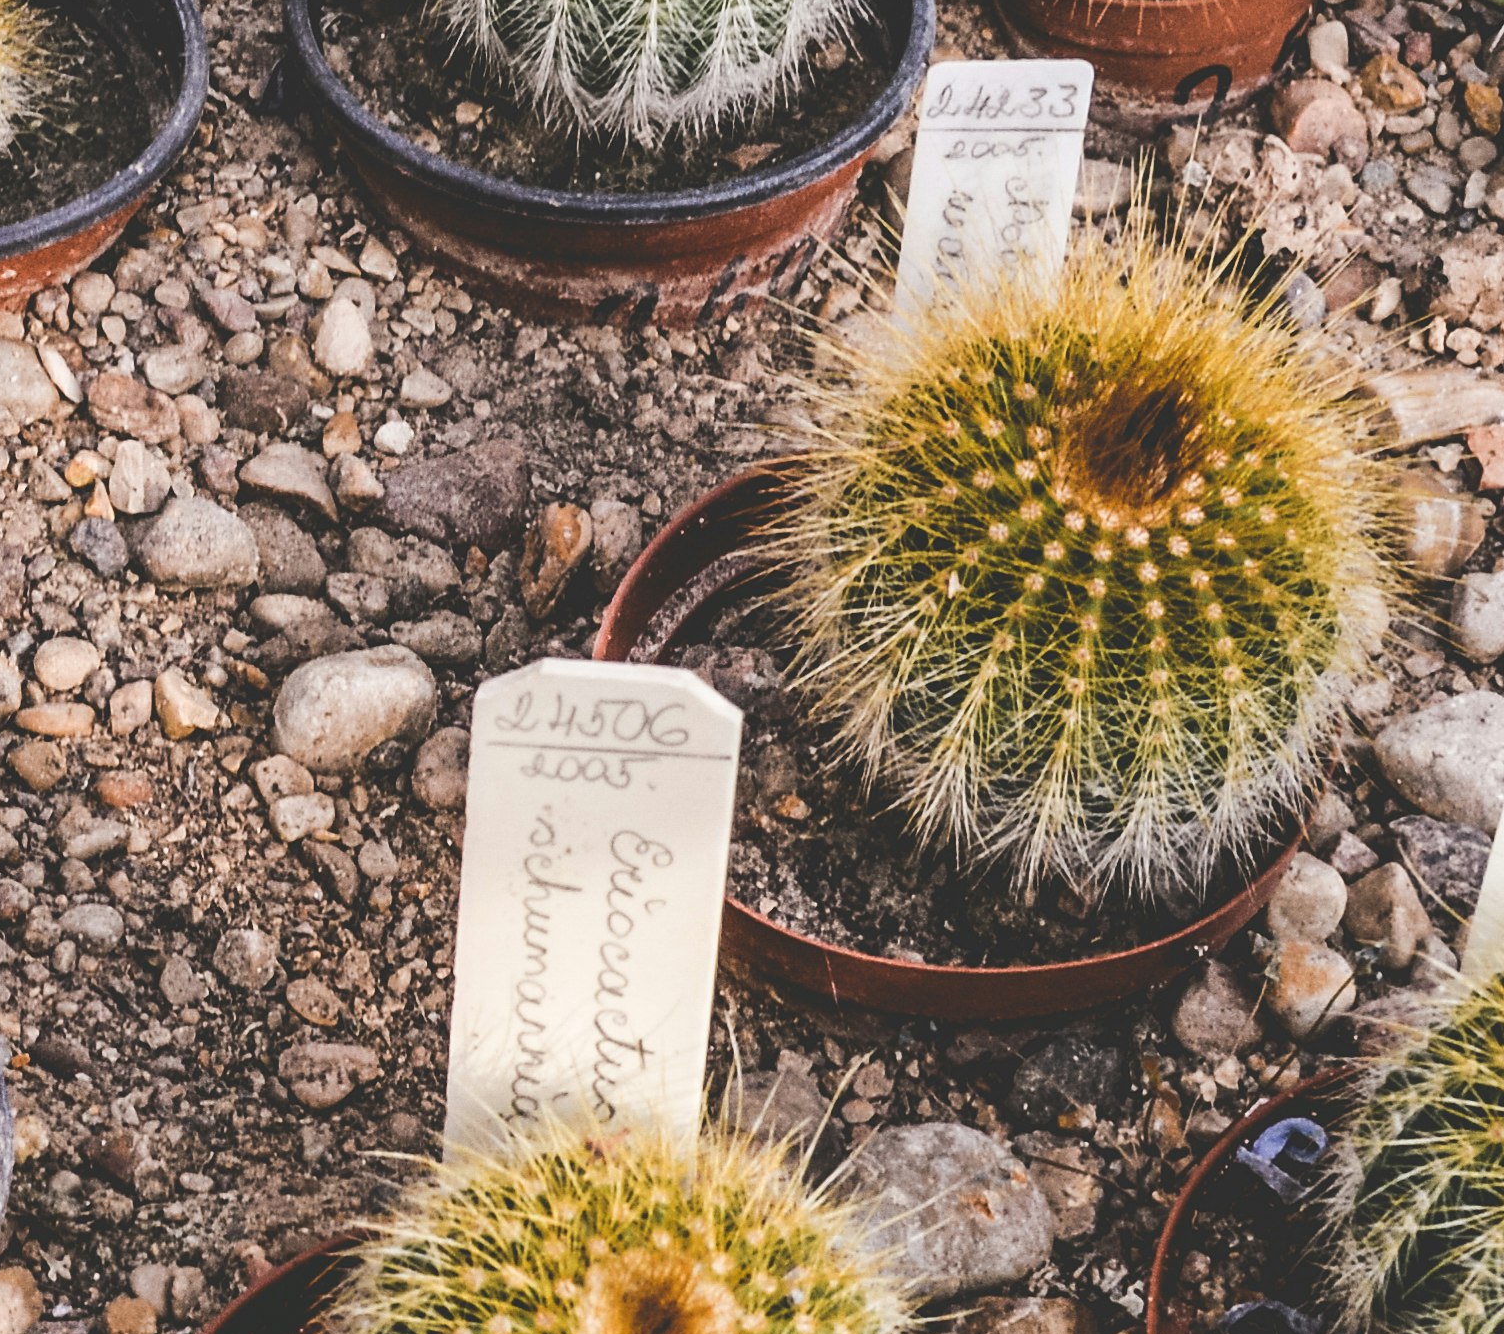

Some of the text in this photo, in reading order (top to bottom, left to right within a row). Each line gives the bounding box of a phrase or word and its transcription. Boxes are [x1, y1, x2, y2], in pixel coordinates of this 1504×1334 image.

[923, 81, 1079, 121] 24233
[492, 691, 691, 760] 24506
[589, 827, 675, 1125] Eriocactus
